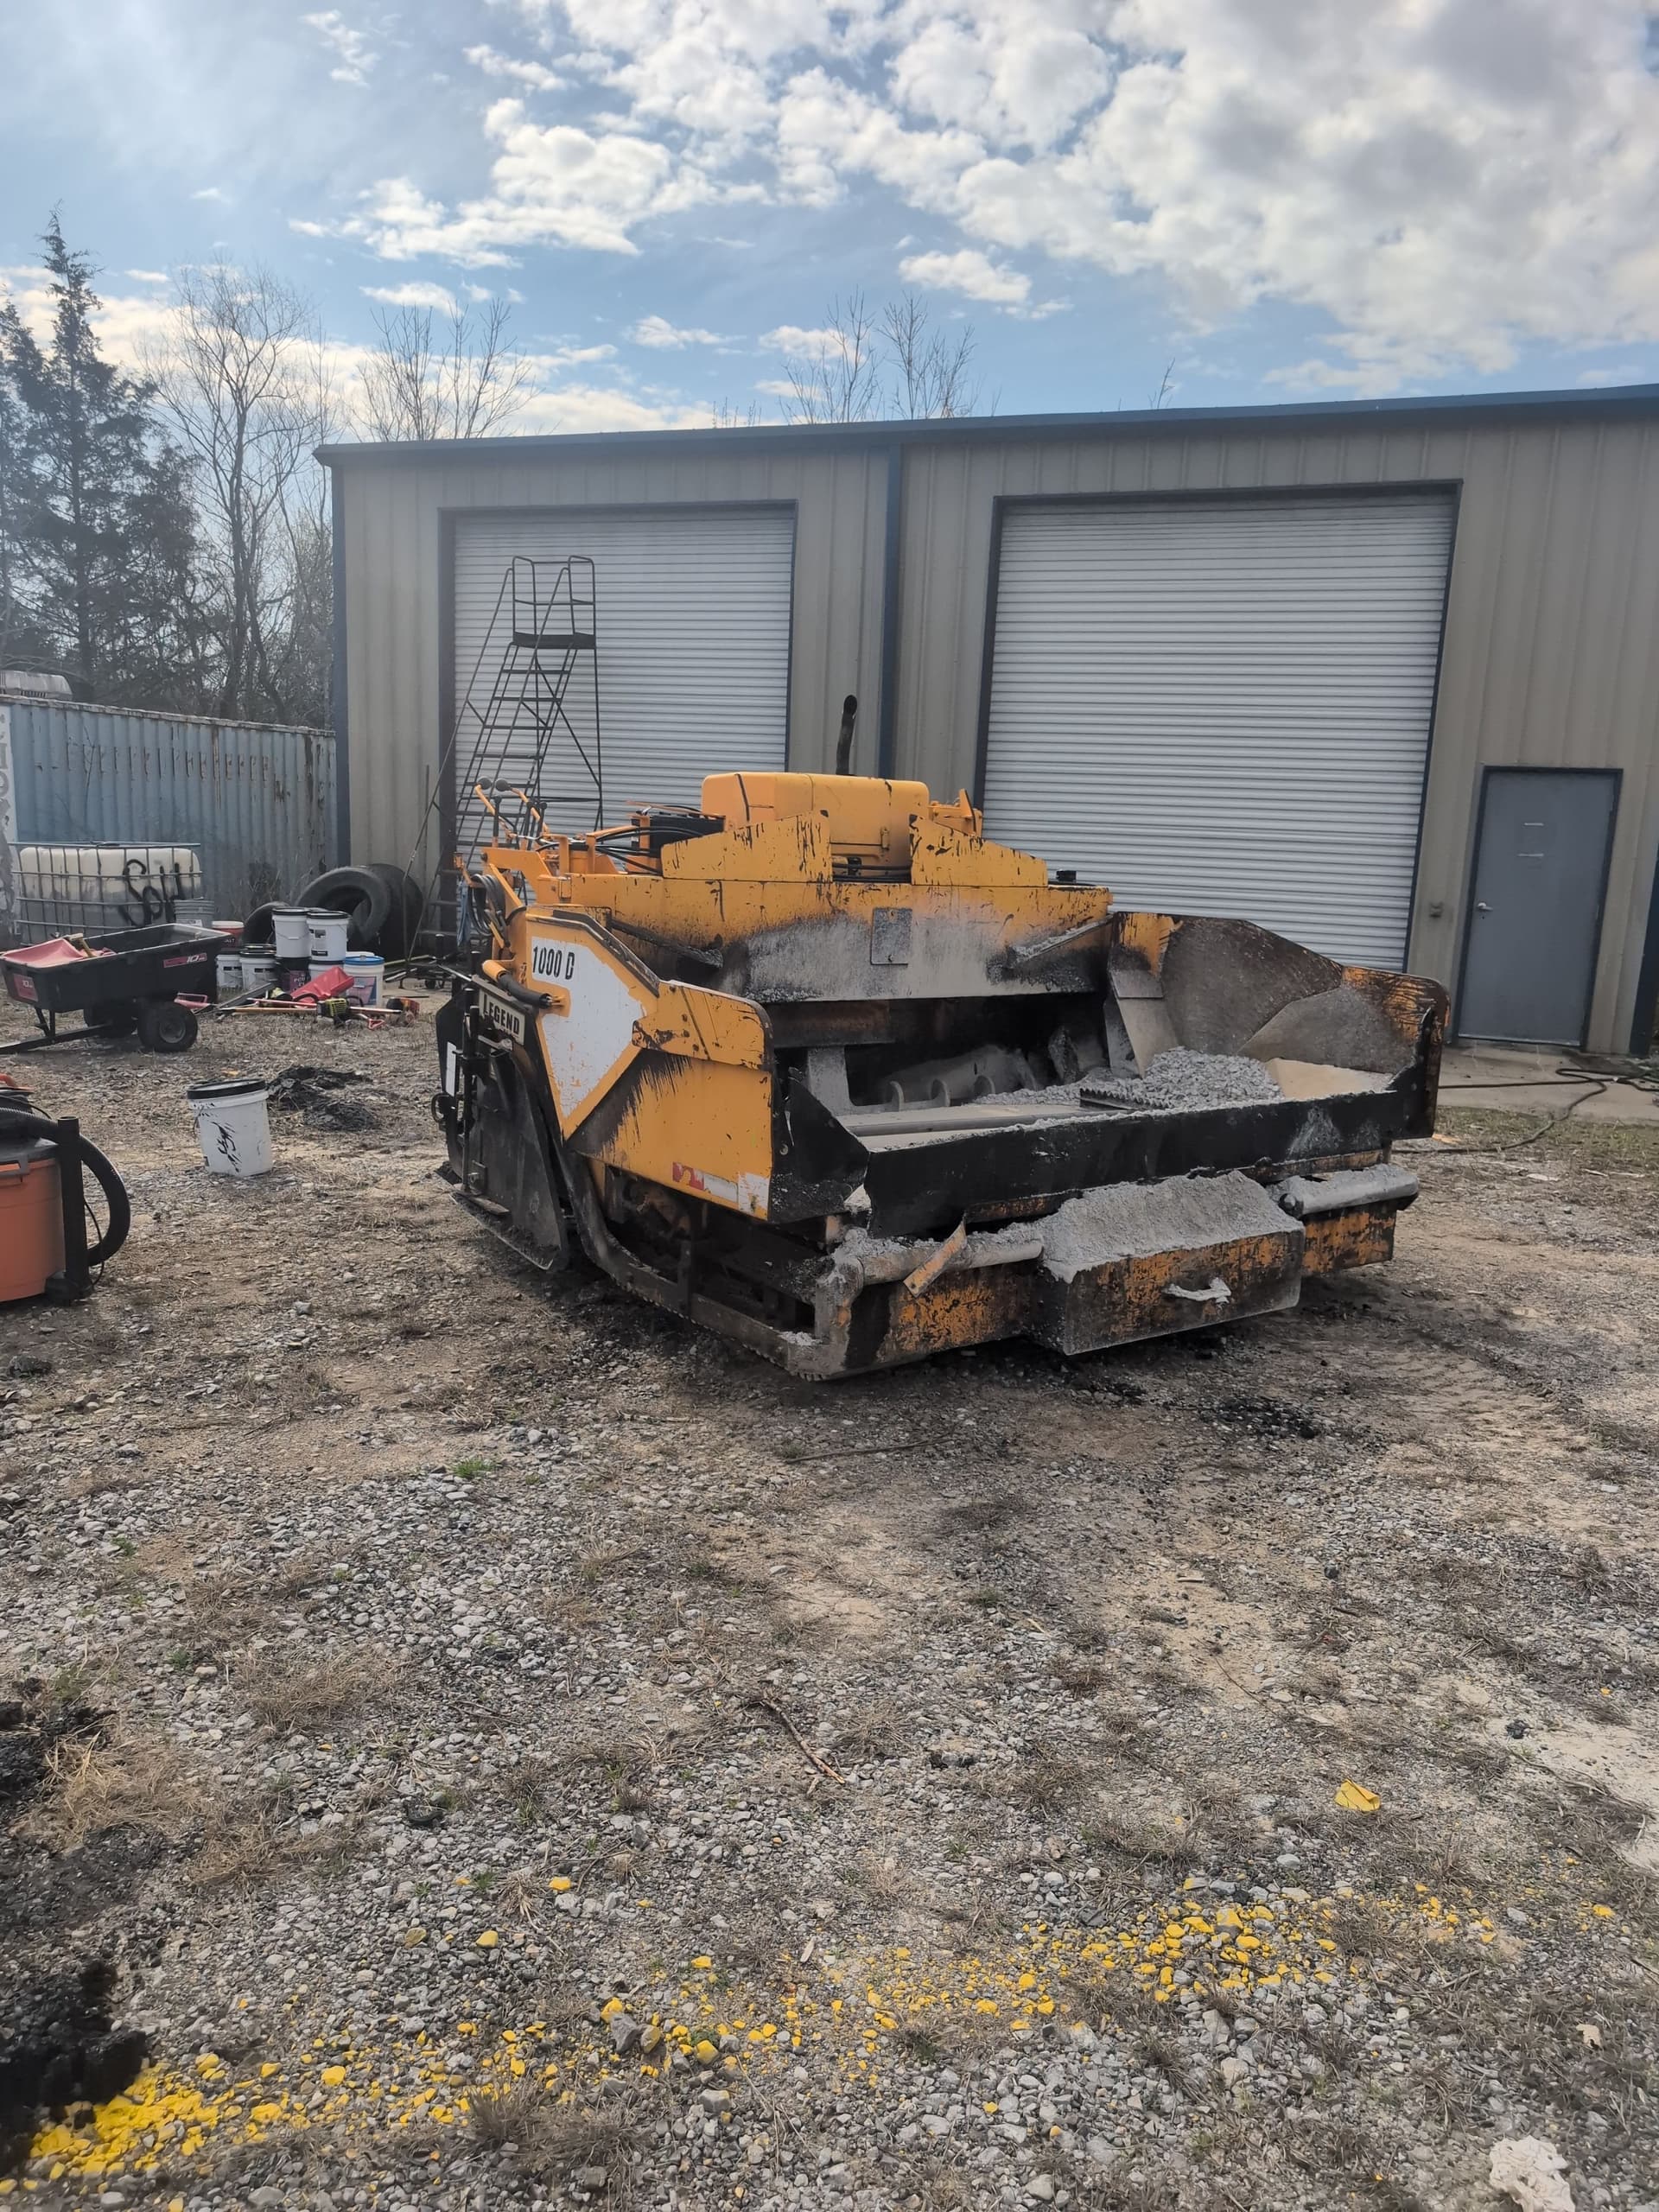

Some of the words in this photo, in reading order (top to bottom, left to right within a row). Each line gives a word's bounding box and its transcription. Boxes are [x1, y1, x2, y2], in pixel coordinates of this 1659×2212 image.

[532, 945, 563, 977] 1000
[565, 951, 575, 980] D
[483, 994, 519, 1035] LEGEND
